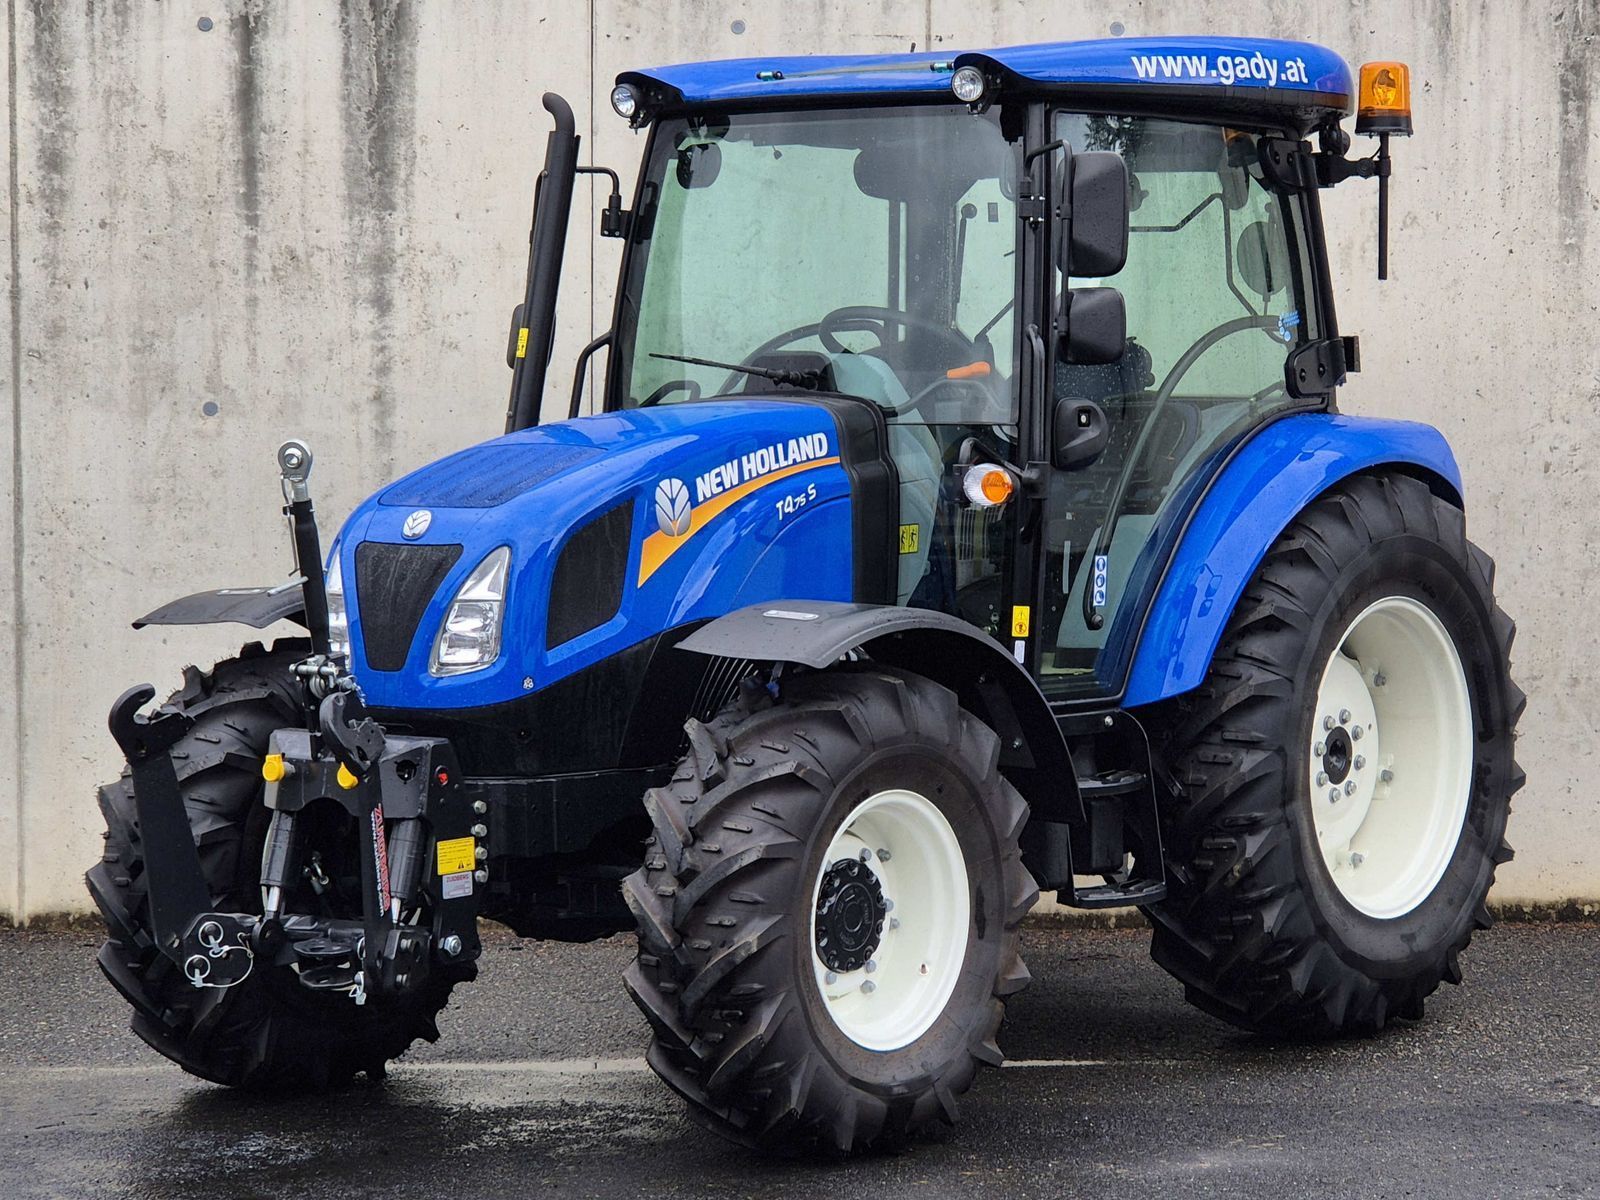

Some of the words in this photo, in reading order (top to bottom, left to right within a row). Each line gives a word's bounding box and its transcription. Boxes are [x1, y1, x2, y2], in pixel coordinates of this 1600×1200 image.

[1131, 52, 1308, 85] www.gady.at
[696, 459, 739, 503] NEW
[741, 432, 828, 480] HOLLAND
